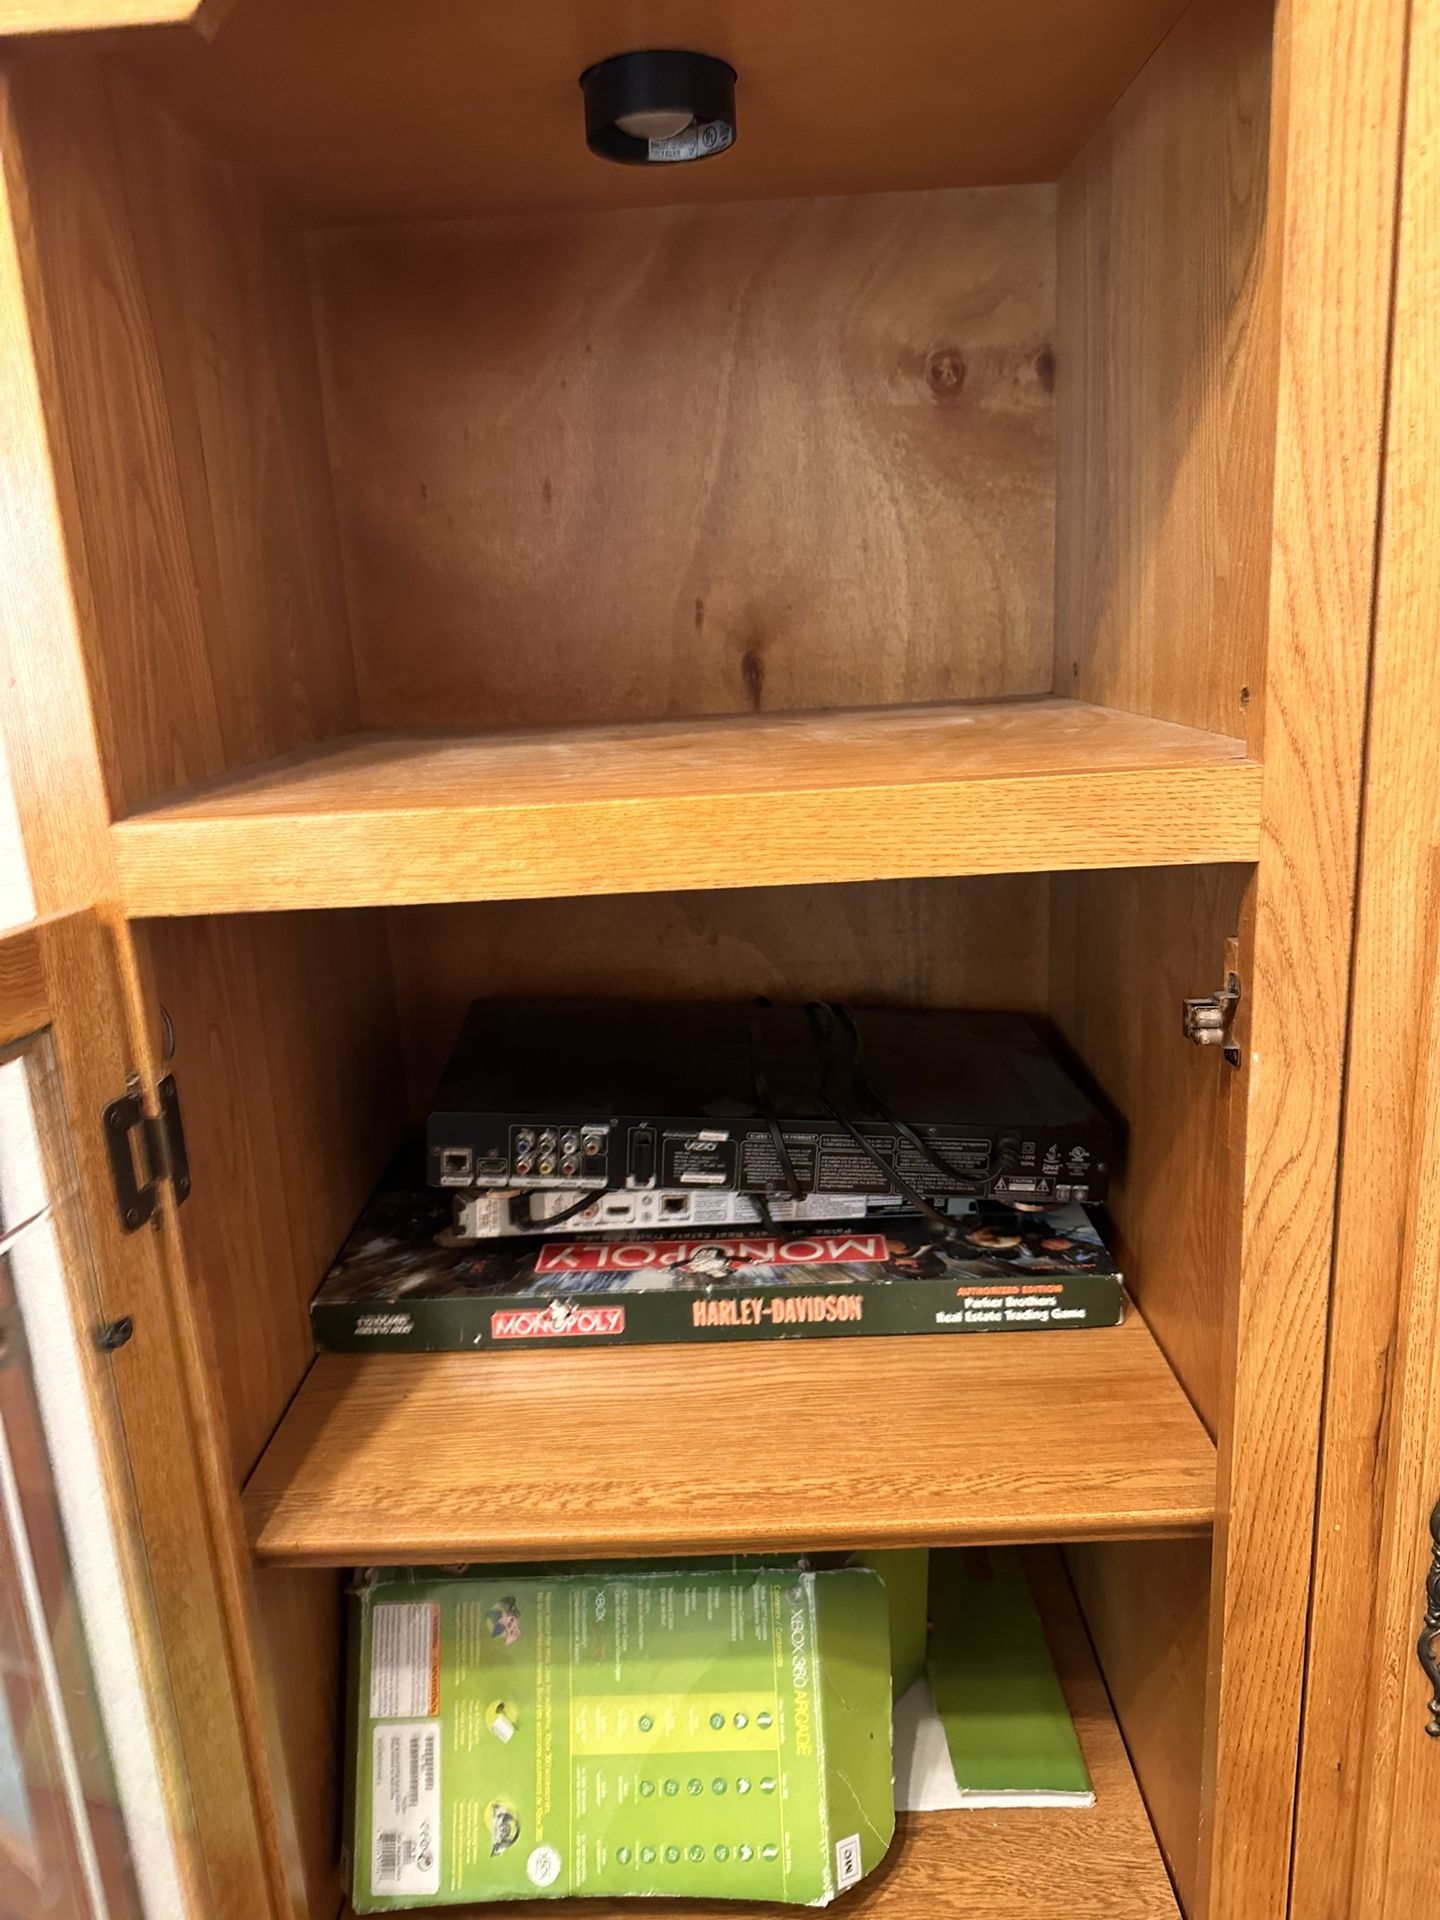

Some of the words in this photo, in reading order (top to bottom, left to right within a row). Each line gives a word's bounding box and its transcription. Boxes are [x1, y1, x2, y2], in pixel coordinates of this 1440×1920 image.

[692, 1294, 864, 1327] HARLEY-DAVIDSON
[936, 1311, 963, 1323] Real
[964, 1310, 1002, 1322] Estate
[1004, 1308, 1049, 1321] Trading
[1051, 1307, 1086, 1319] Game
[964, 1297, 1003, 1308] Parker
[1005, 1295, 1057, 1307] Brothers
[496, 1310, 622, 1335] MONOPOLY
[791, 1608, 804, 1653] XBOX
[791, 1654, 807, 1688] 360
[794, 1689, 811, 1756] ARCADE
